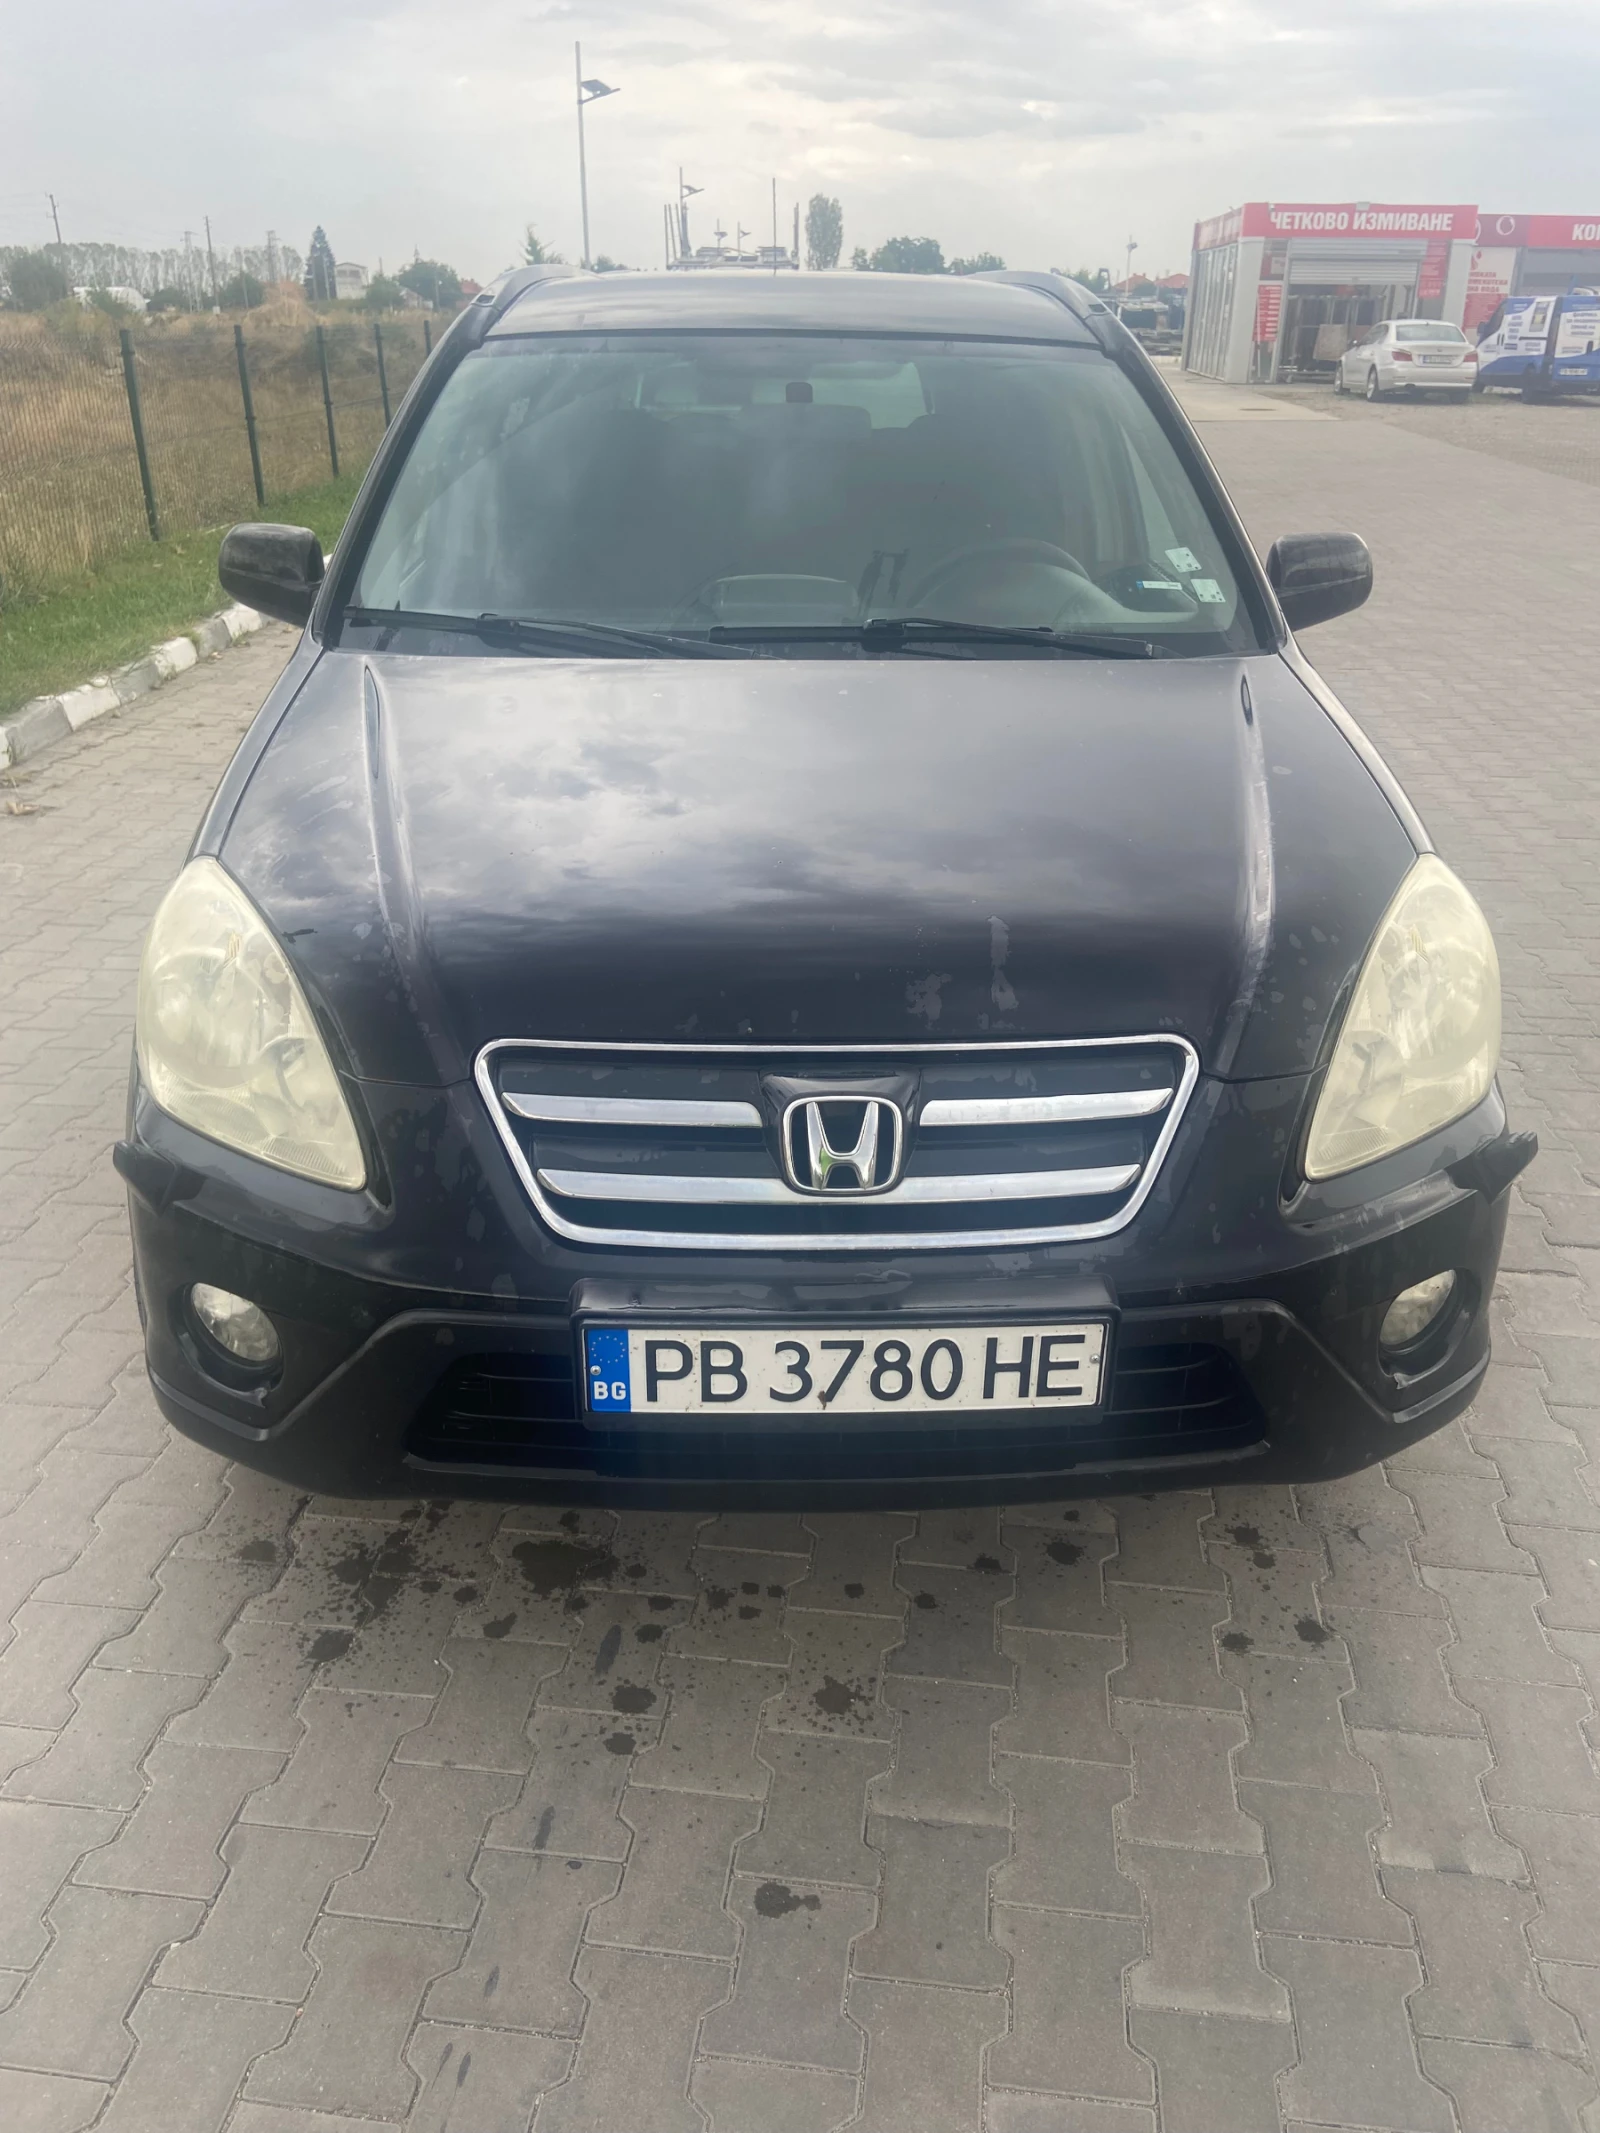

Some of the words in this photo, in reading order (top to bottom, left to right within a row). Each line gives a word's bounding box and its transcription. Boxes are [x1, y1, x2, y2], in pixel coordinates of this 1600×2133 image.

[1270, 212, 1349, 230] ЧЕТКОВО
[1353, 213, 1454, 231] ИЗМИВАНЕ
[645, 1340, 748, 1403] PB
[769, 1338, 964, 1402] 3780
[982, 1334, 1086, 1399] HE
[593, 1381, 627, 1400] BG
